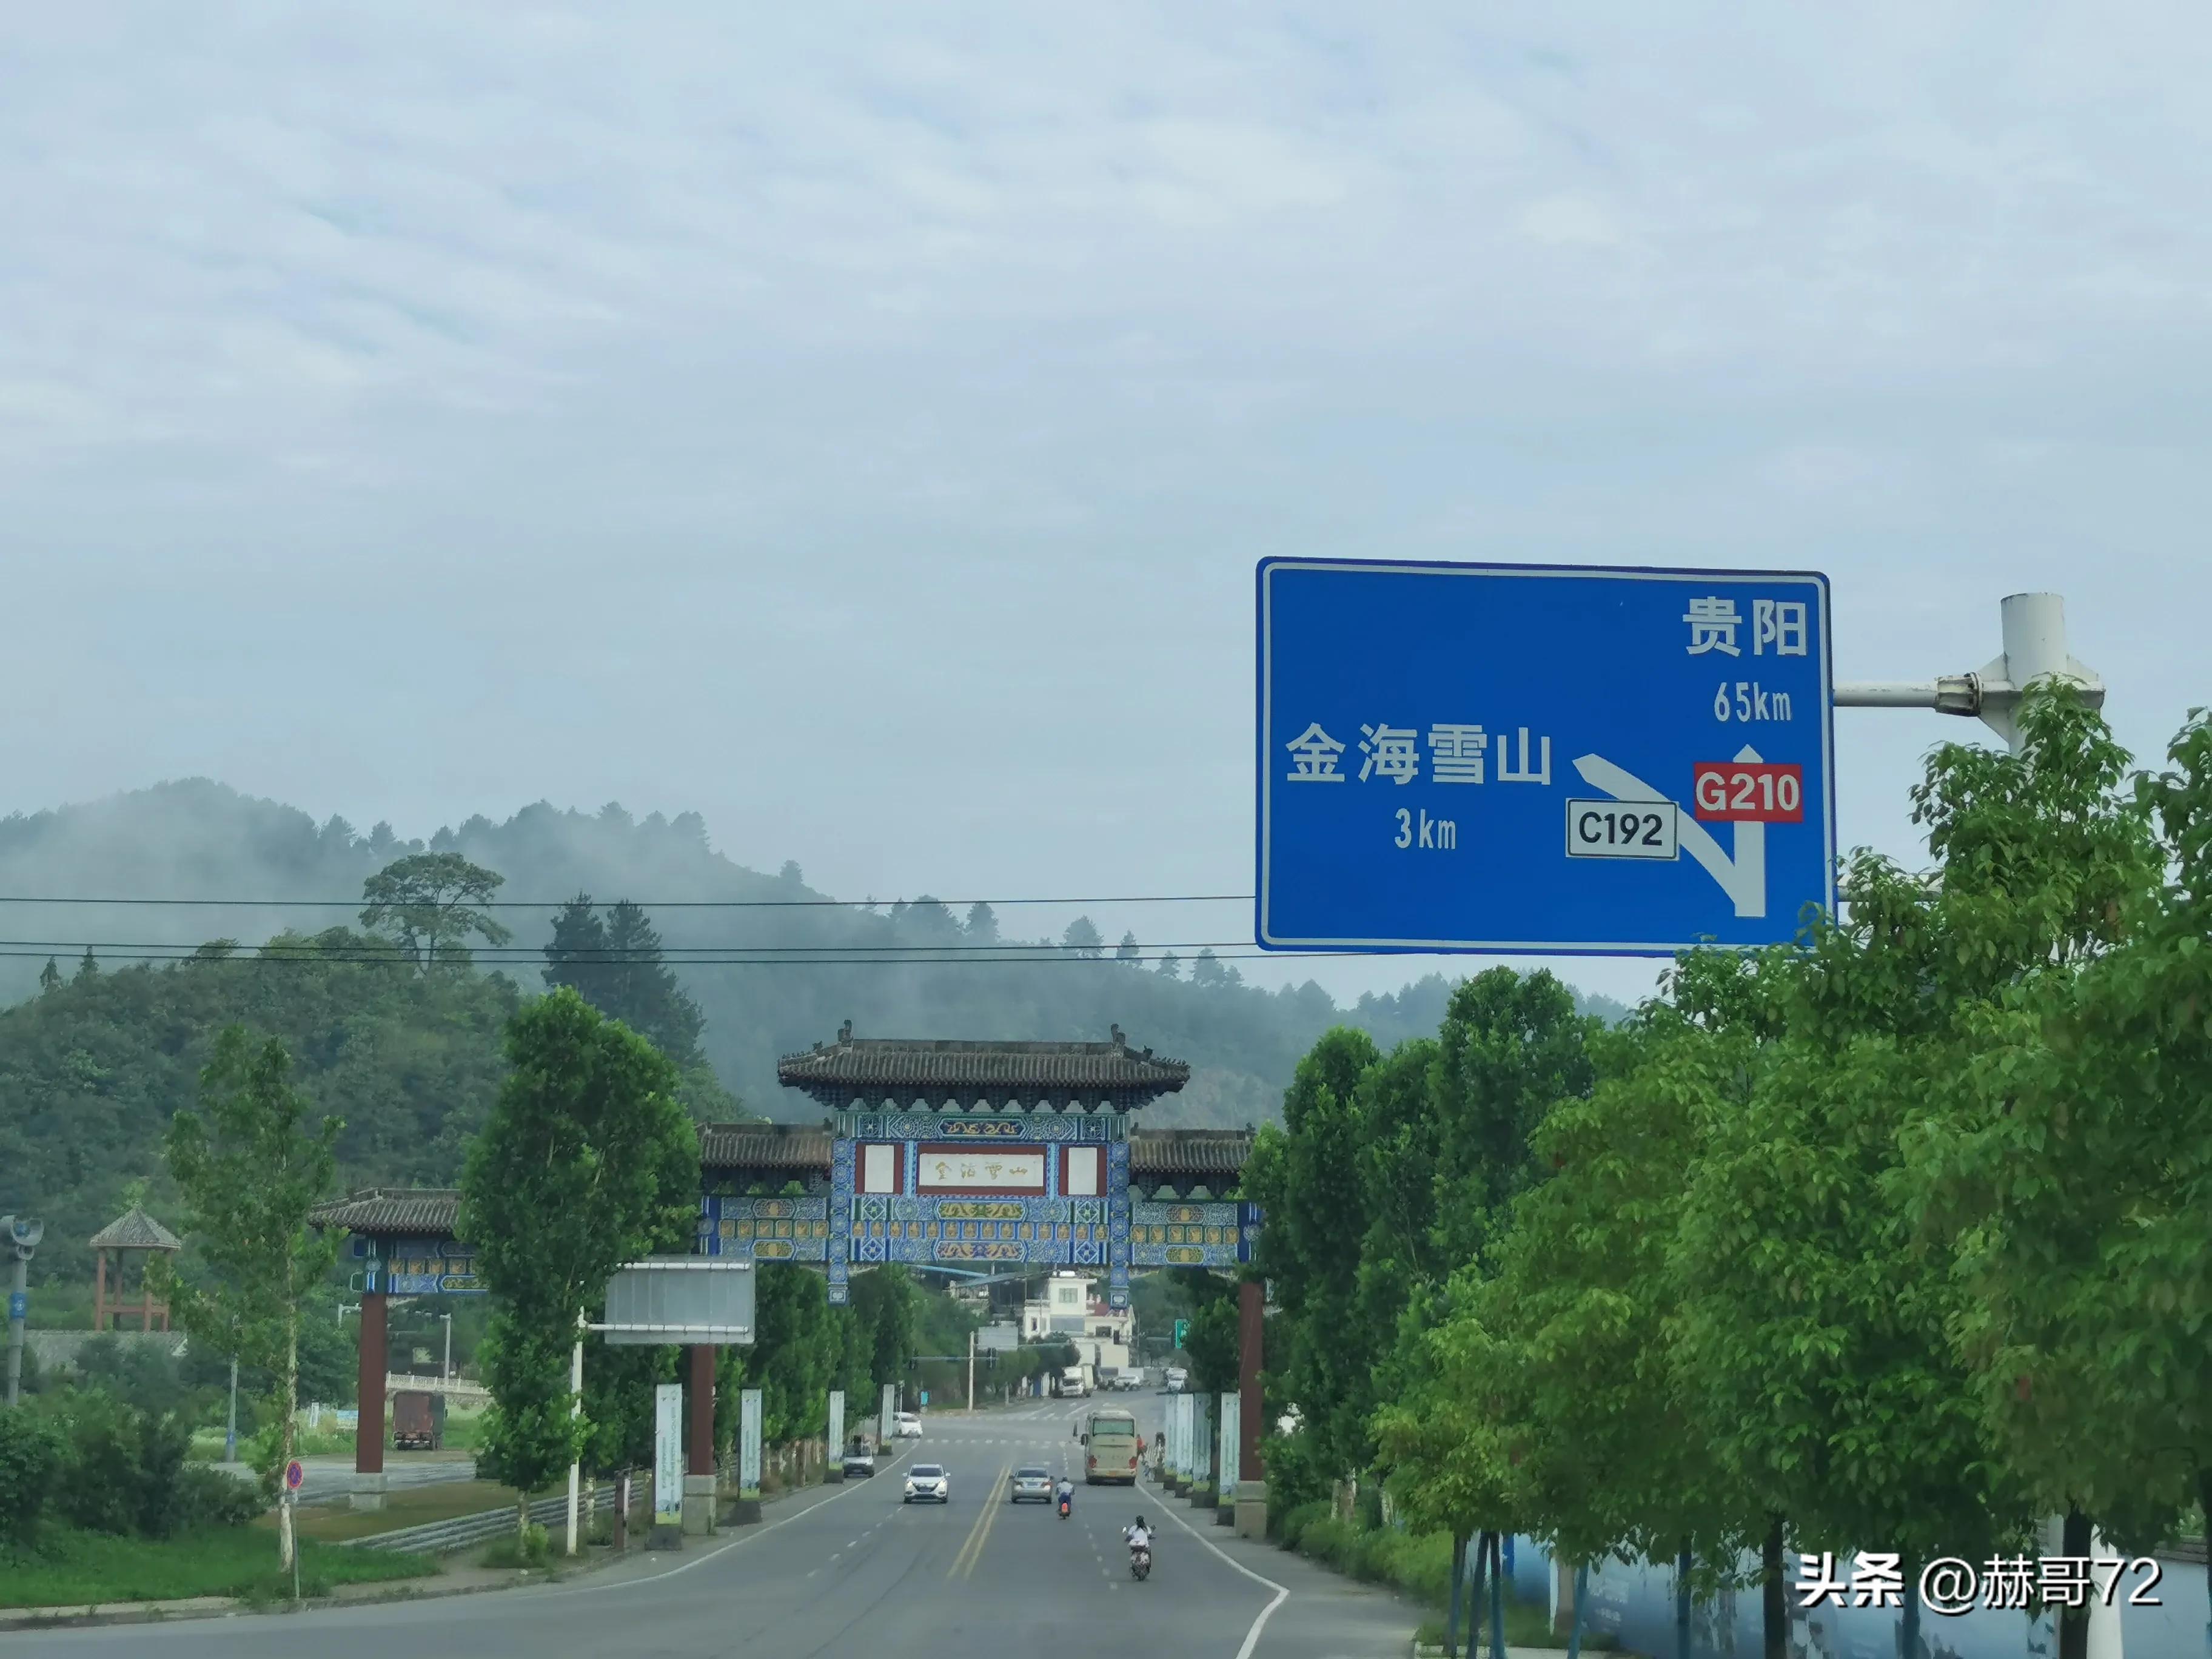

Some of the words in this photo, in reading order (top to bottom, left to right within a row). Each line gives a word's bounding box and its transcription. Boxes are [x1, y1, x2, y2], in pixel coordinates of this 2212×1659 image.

[1683, 596, 1808, 657] 贵阳
[1714, 682, 1792, 722] 65km
[1286, 722, 1551, 785] 金海雪山
[1696, 771, 1800, 811] G210
[1579, 812, 1663, 846] C192
